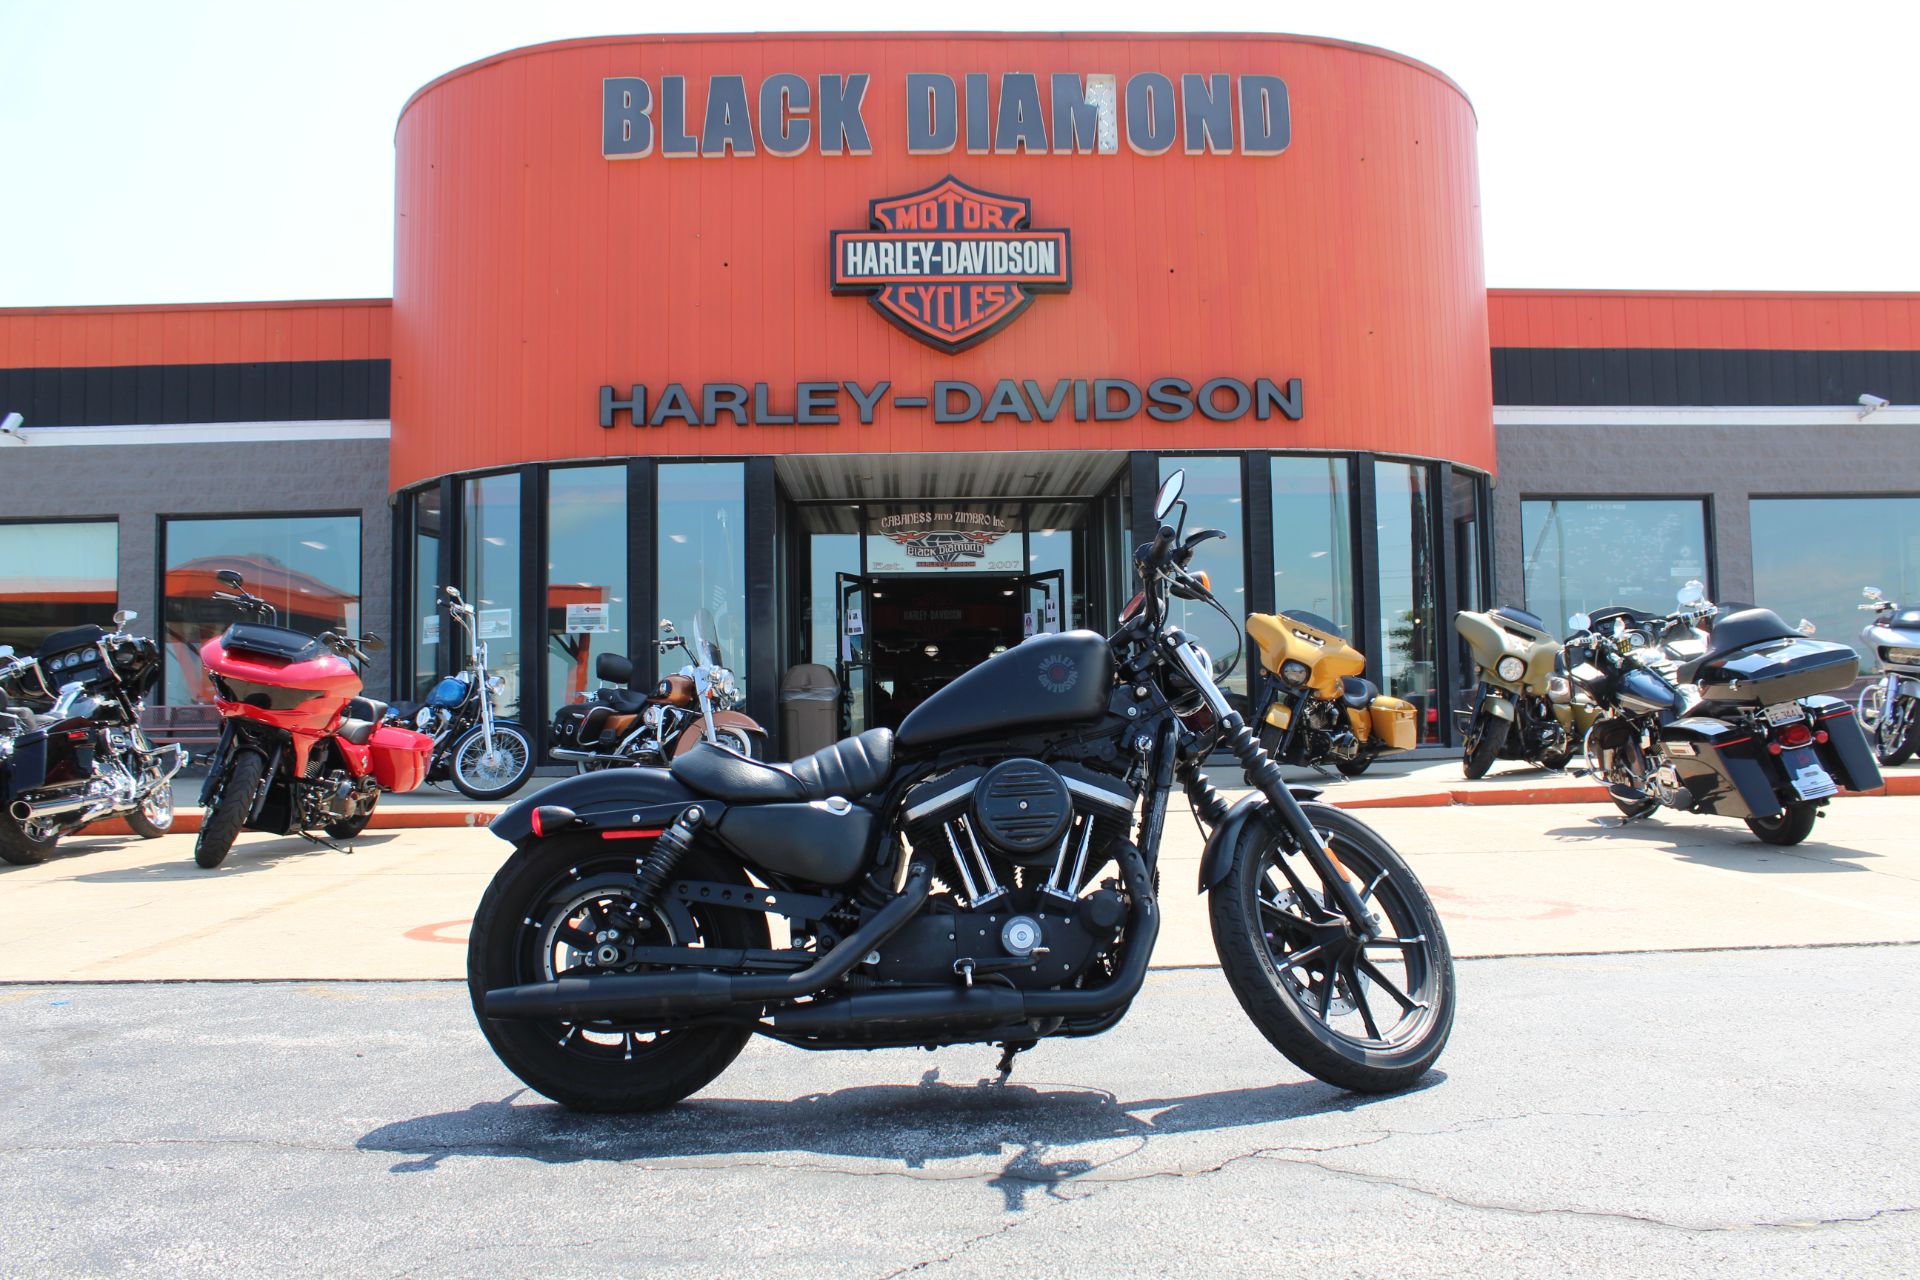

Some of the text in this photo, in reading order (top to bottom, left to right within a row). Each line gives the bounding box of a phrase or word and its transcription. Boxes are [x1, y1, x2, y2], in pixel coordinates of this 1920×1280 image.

[601, 72, 1291, 160] BLACK DIAMOND
[895, 190, 1005, 230] MOTOR
[847, 241, 1055, 275] HARLEY-DAVIDSON
[898, 285, 1006, 332] CYCLES
[600, 378, 1303, 428] HARLEY-DAVIDSON
[881, 511, 932, 528] CABANESS
[955, 511, 990, 526] ZIMBRO
[987, 560, 1020, 570] 2007
